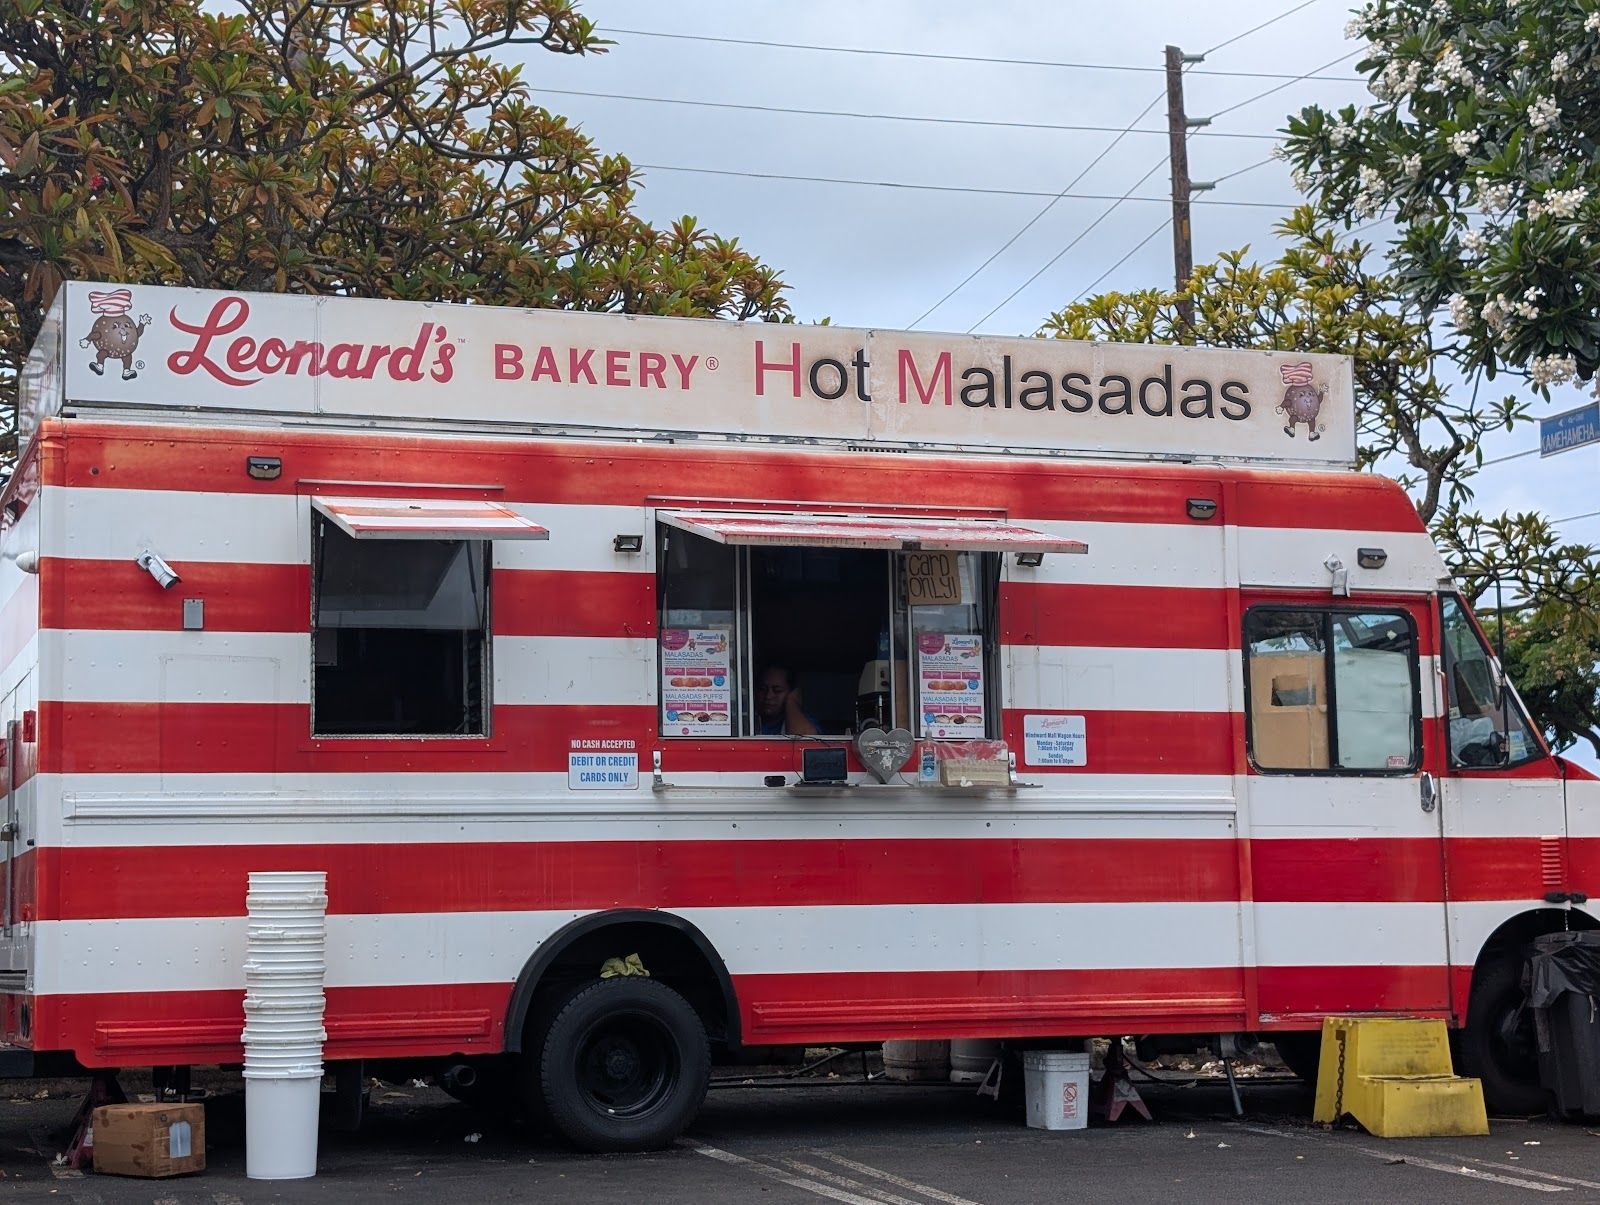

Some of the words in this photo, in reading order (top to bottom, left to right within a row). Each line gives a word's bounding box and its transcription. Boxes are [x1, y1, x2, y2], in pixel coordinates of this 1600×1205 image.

[754, 340, 872, 402] Hot
[897, 349, 1252, 421] Malasadas
[1541, 423, 1595, 451] KAMEHAMEHA
[571, 739, 581, 749] NO
[582, 739, 600, 749] CASH
[601, 740, 635, 749] ACCEPTED
[571, 756, 594, 766] DEBIT
[595, 756, 606, 766] OR
[608, 756, 636, 767] CREDIT
[580, 772, 606, 782] CARDS
[608, 772, 629, 782] ONLY
